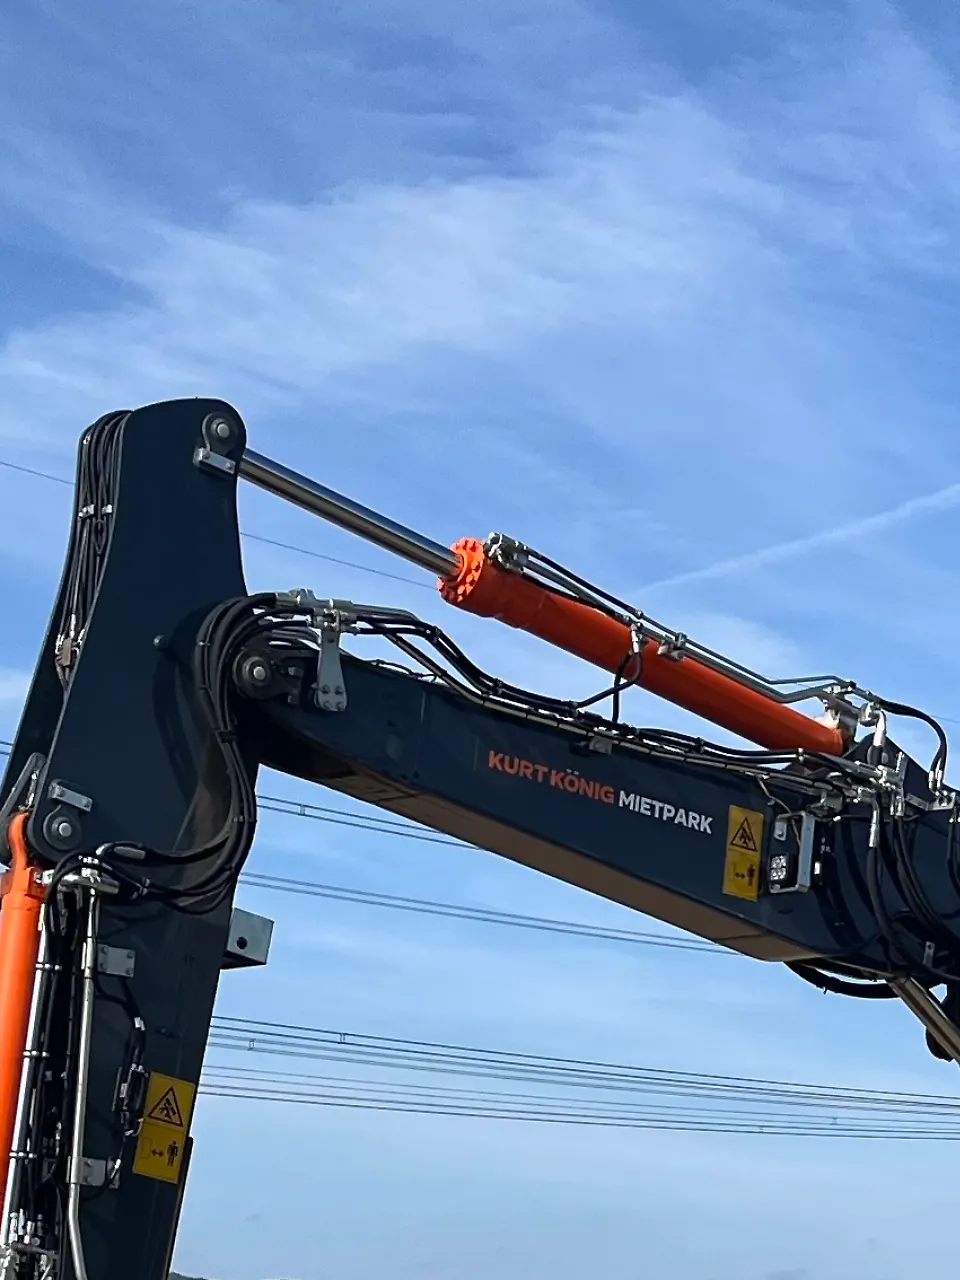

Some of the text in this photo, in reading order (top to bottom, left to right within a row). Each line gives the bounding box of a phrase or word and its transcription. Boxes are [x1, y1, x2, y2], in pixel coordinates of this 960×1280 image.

[488, 750, 713, 835] KURT KÖNIG MIETPARK
